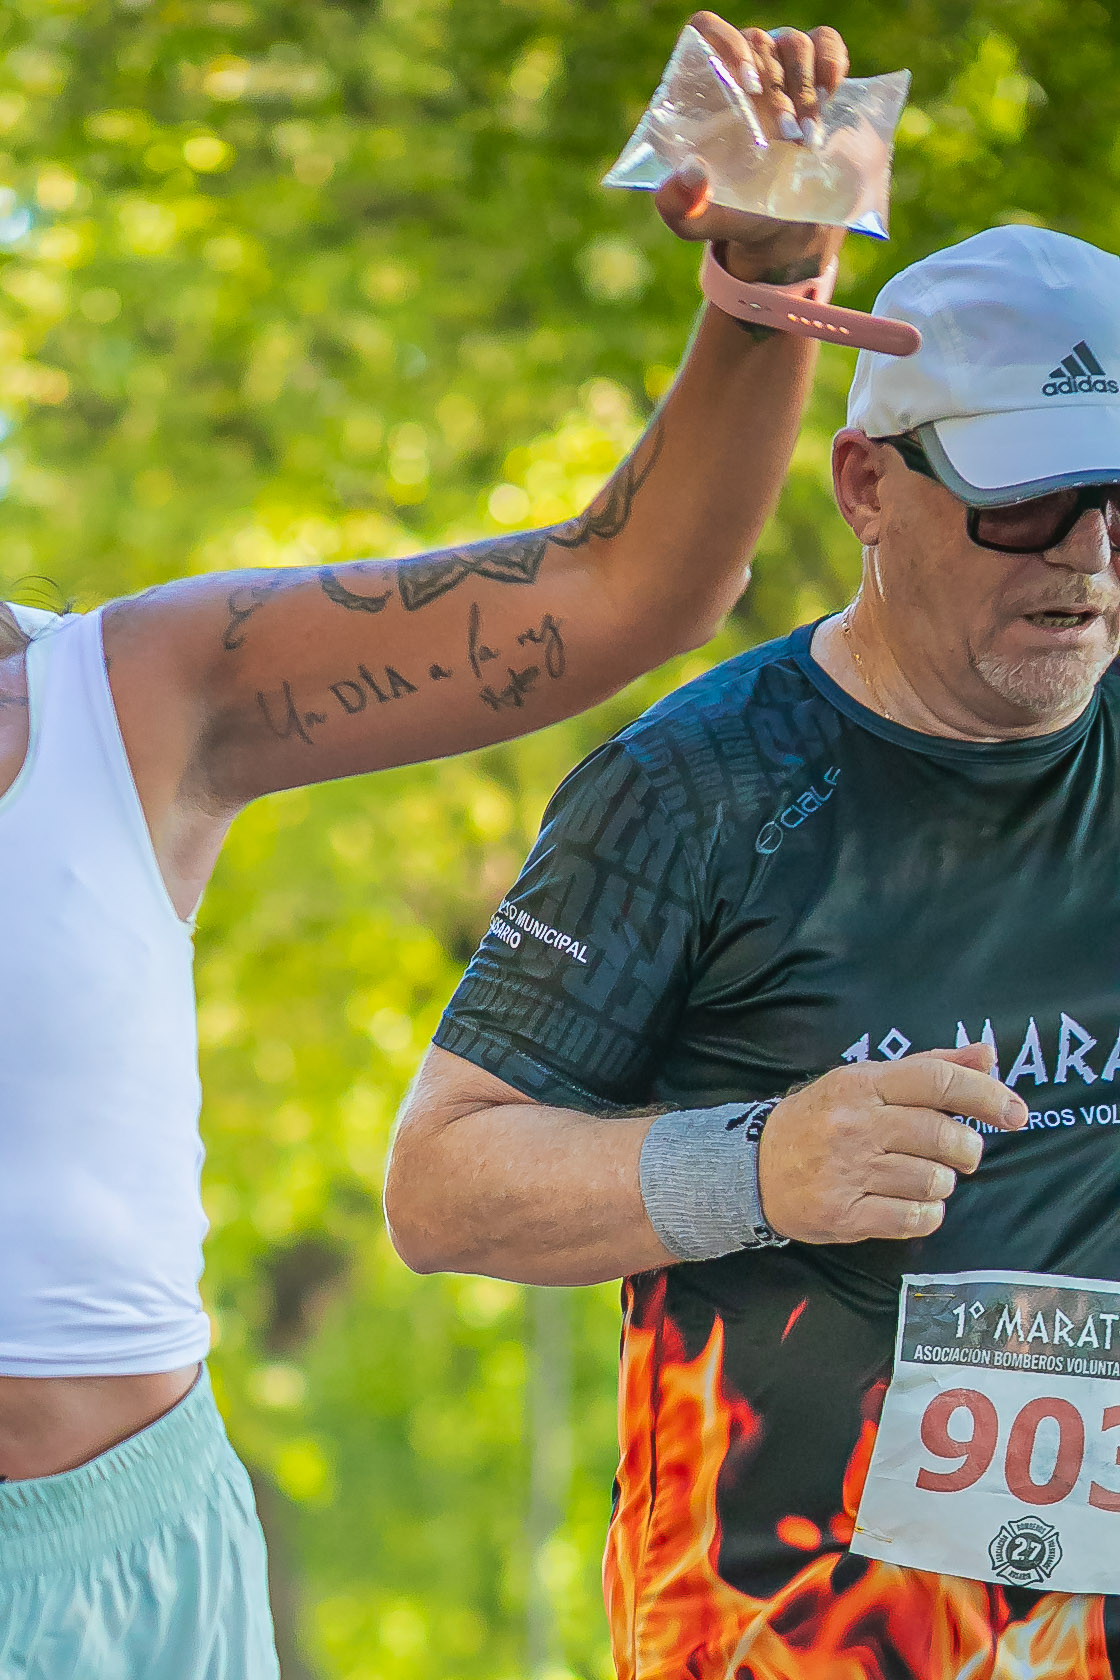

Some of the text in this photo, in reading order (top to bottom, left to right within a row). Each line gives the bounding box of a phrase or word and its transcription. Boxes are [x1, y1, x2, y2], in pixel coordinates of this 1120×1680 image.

[1042, 376, 1119, 396] adidas
[514, 910, 588, 964] MUNICIPAL
[993, 1304, 1120, 1350] MARAT
[994, 1350, 1064, 1372] BOMBEROS
[1011, 1537, 1042, 1561] 27
